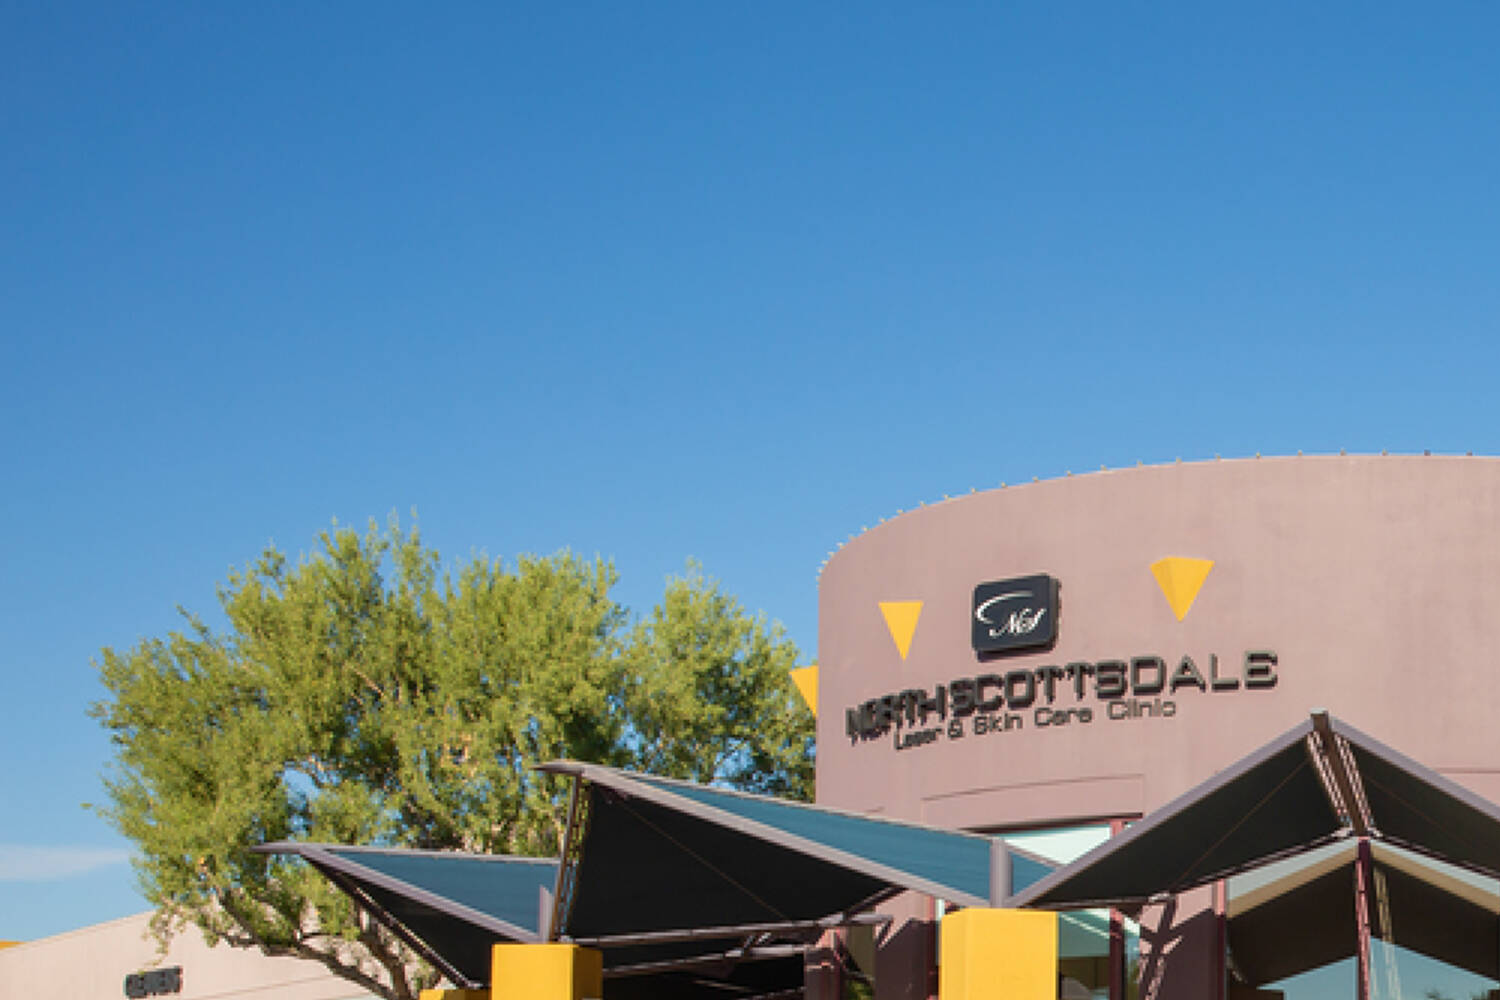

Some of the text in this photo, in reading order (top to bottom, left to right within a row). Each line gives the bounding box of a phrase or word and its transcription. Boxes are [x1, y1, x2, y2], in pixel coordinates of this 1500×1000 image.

[845, 651, 1278, 745] NORTH SCOTTSDALE
[974, 713, 1023, 735] Skin
[1034, 706, 1092, 727] Care
[1106, 699, 1176, 720] Clinic
